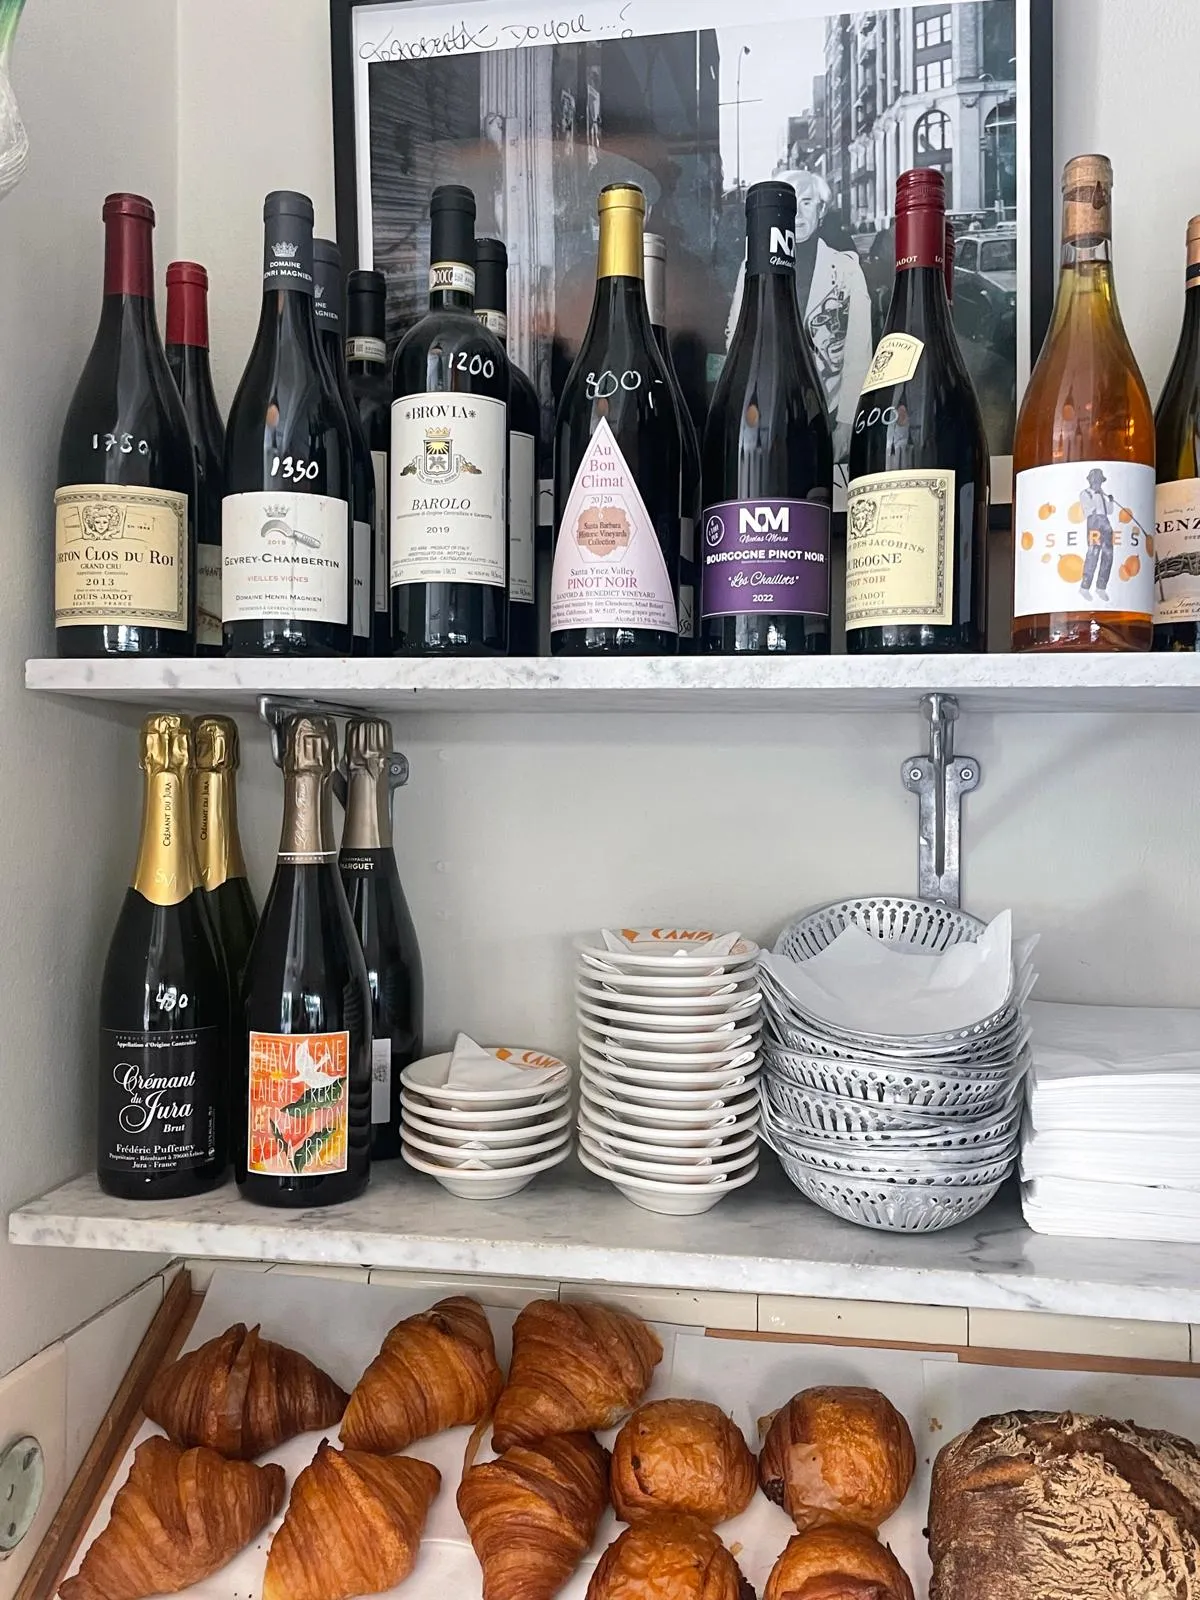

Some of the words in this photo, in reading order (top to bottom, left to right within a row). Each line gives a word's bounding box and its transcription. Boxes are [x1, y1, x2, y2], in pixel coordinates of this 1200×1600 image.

[448, 352, 494, 378] 1200
[412, 406, 468, 419] BROVIA
[855, 407, 898, 434] 600
[592, 445, 612, 456] Au
[271, 456, 319, 482] 1350
[590, 460, 616, 472] Bon
[581, 475, 624, 488] Climat
[411, 498, 472, 511] BAROLO
[426, 526, 450, 534] 2019
[1045, 530, 1140, 548] SERES
[868, 538, 926, 553] JACOBINS
[84, 546, 118, 562] CLOS
[124, 551, 144, 562] DU
[149, 550, 174, 566] ROI
[224, 553, 340, 569] GEVREY-CHAMBERTIN
[706, 550, 766, 565] BOURGOGNE
[768, 550, 802, 560] PINOT
[804, 551, 824, 562] NOIR
[570, 568, 588, 576] Santa
[611, 567, 634, 576] Valley
[85, 578, 115, 587] 2013
[248, 575, 280, 583] VIEILLES
[567, 577, 602, 589] PINOT
[605, 577, 638, 588] NOIR
[73, 593, 98, 601] LOUIS
[100, 593, 133, 601] JADOT
[289, 594, 323, 602] MAGNIEN
[586, 590, 619, 598] BENEDICT
[621, 590, 656, 598] VINEYARD
[752, 594, 774, 603] 2022
[162, 782, 173, 799] JURA
[117, 1041, 144, 1049] Appellation
[113, 1062, 196, 1096] Crémant
[130, 1093, 142, 1104] du
[119, 1089, 194, 1134] Jura
[163, 1124, 186, 1133] Brut
[116, 1143, 151, 1154] Frédéric
[154, 1143, 195, 1154] Puffeney
[250, 1135, 344, 1169] EXTRA-BRUT
[153, 1160, 178, 1168] France
